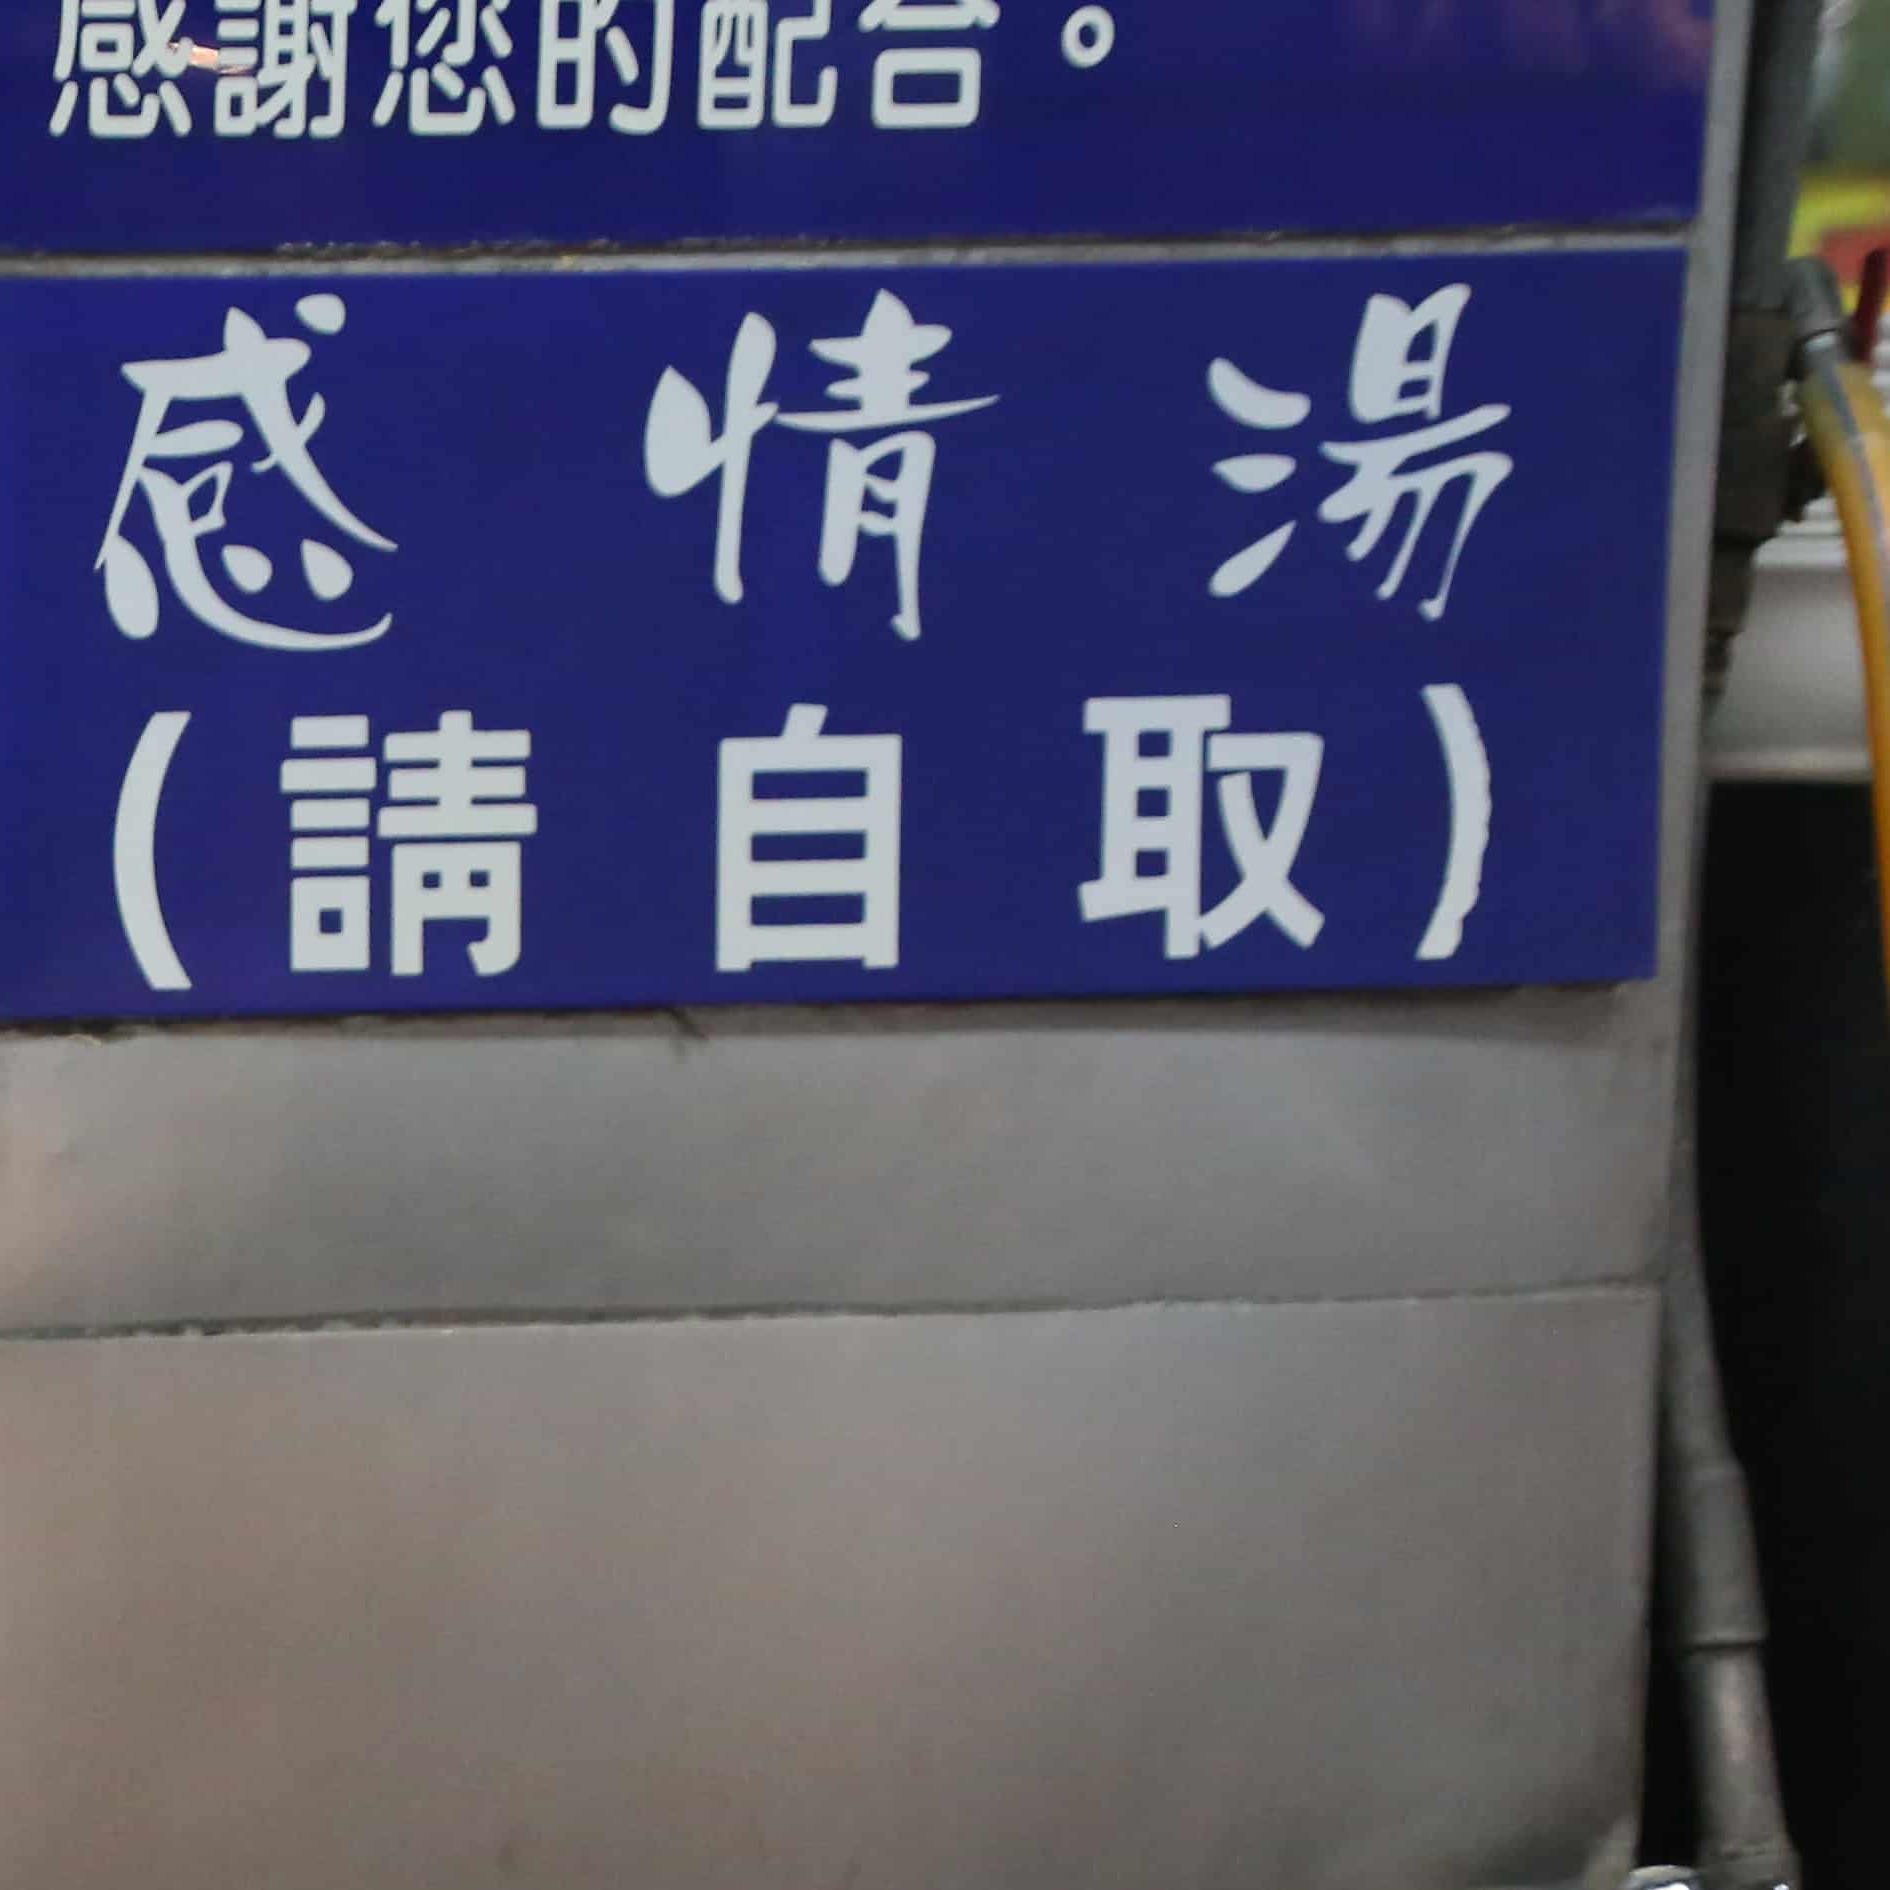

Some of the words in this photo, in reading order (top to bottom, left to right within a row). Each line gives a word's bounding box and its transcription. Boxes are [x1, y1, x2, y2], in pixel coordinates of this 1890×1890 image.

[50, 0, 1115, 138] 感謝您的配合。
[95, 282, 1515, 651] 感情湯
